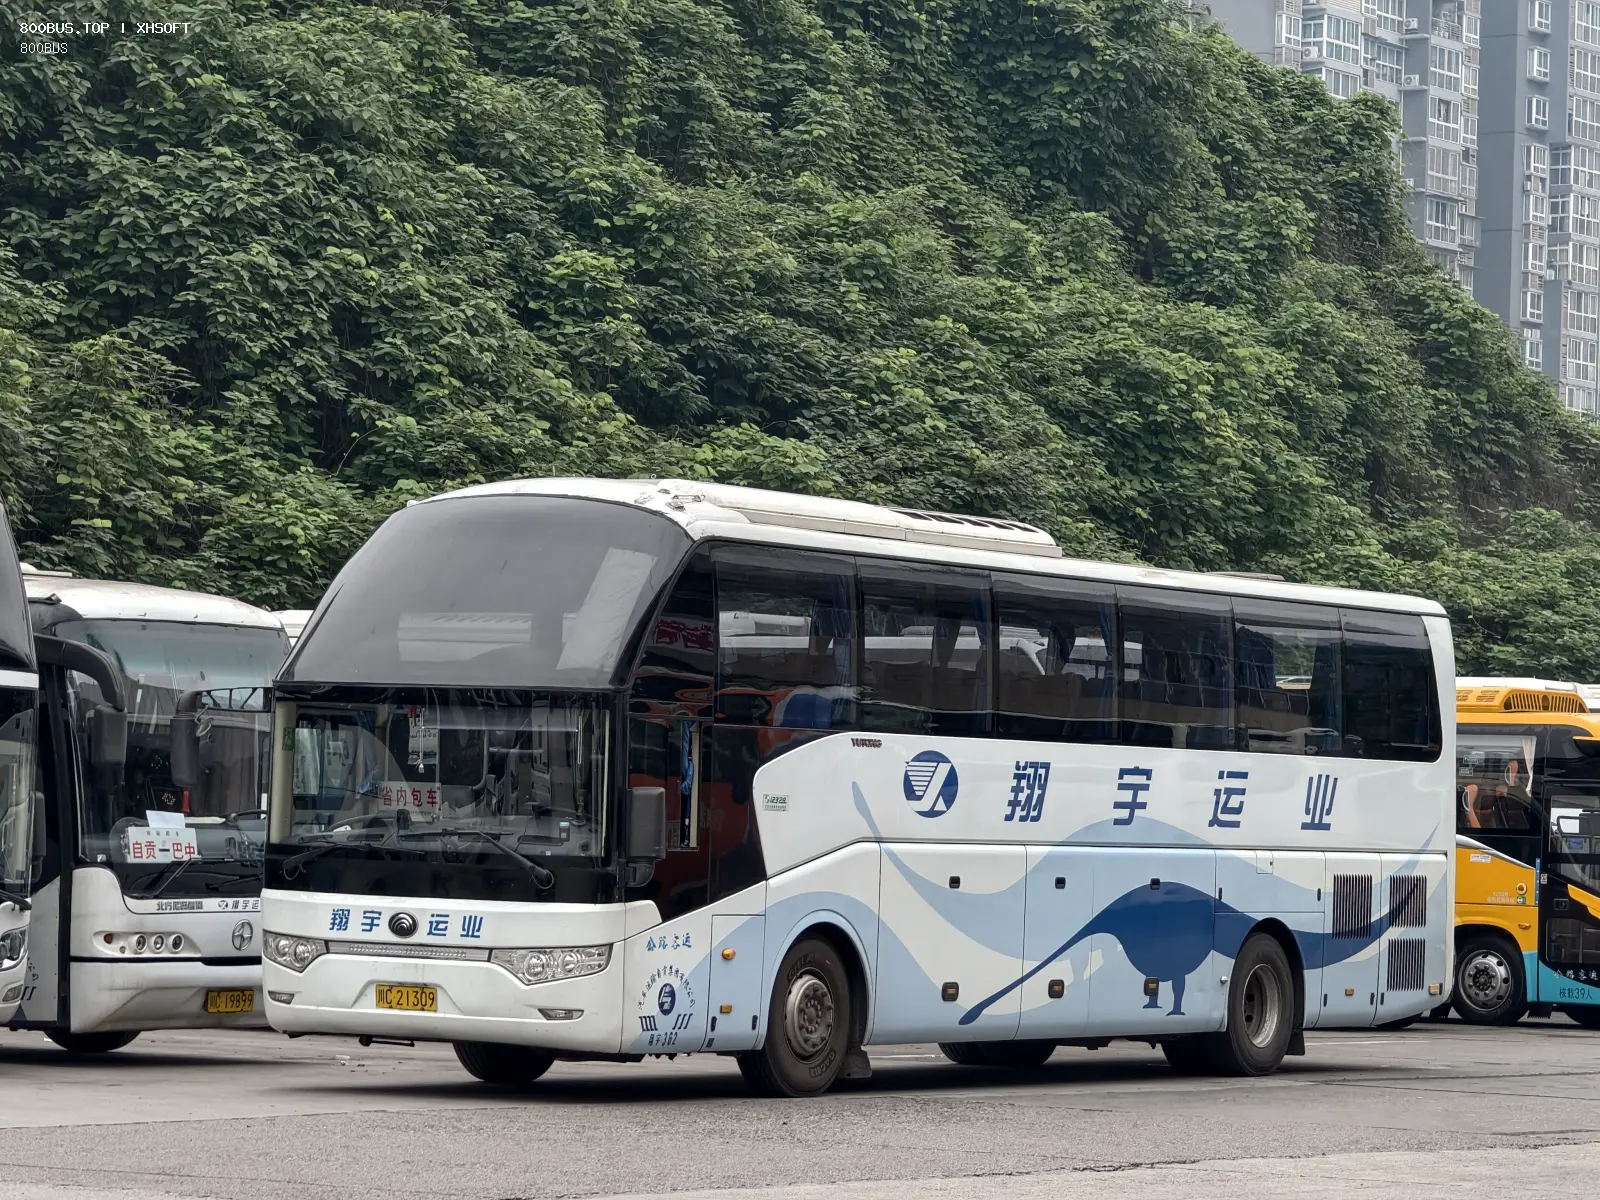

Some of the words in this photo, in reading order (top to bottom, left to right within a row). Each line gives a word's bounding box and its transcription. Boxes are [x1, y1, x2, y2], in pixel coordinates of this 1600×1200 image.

[383, 786, 438, 808] 省内包车
[1004, 761, 1339, 831] 翔宇运业
